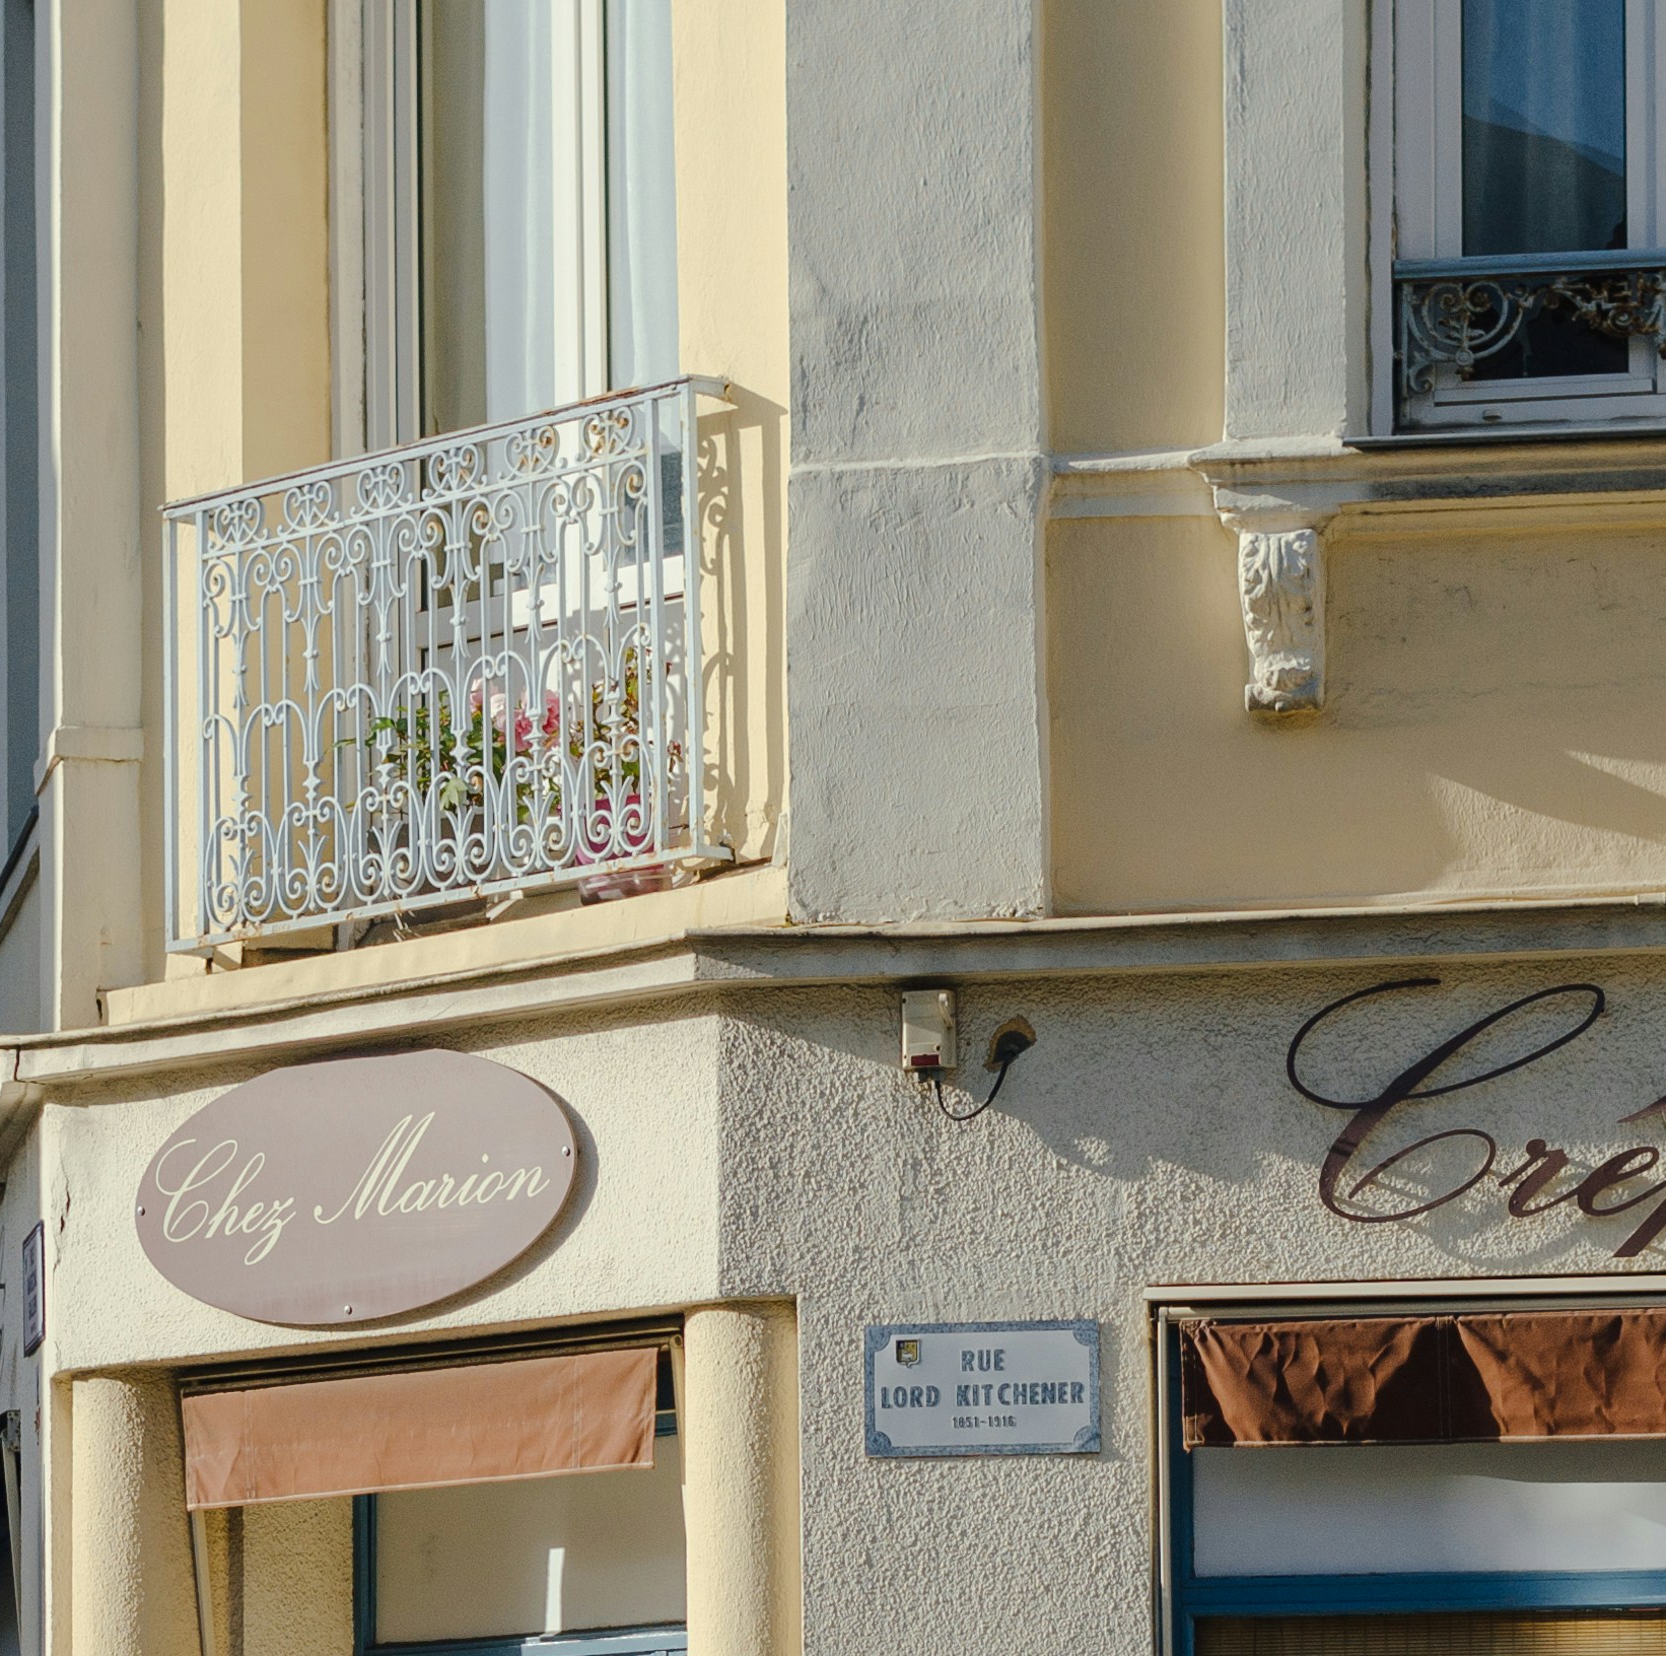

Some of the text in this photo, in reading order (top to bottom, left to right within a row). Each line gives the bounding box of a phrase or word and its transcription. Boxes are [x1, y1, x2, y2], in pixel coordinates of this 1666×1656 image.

[154, 1110, 551, 1267] Chez Marion
[960, 1348, 1007, 1373] RUE
[880, 1380, 1085, 1410] LORD KITCHENER
